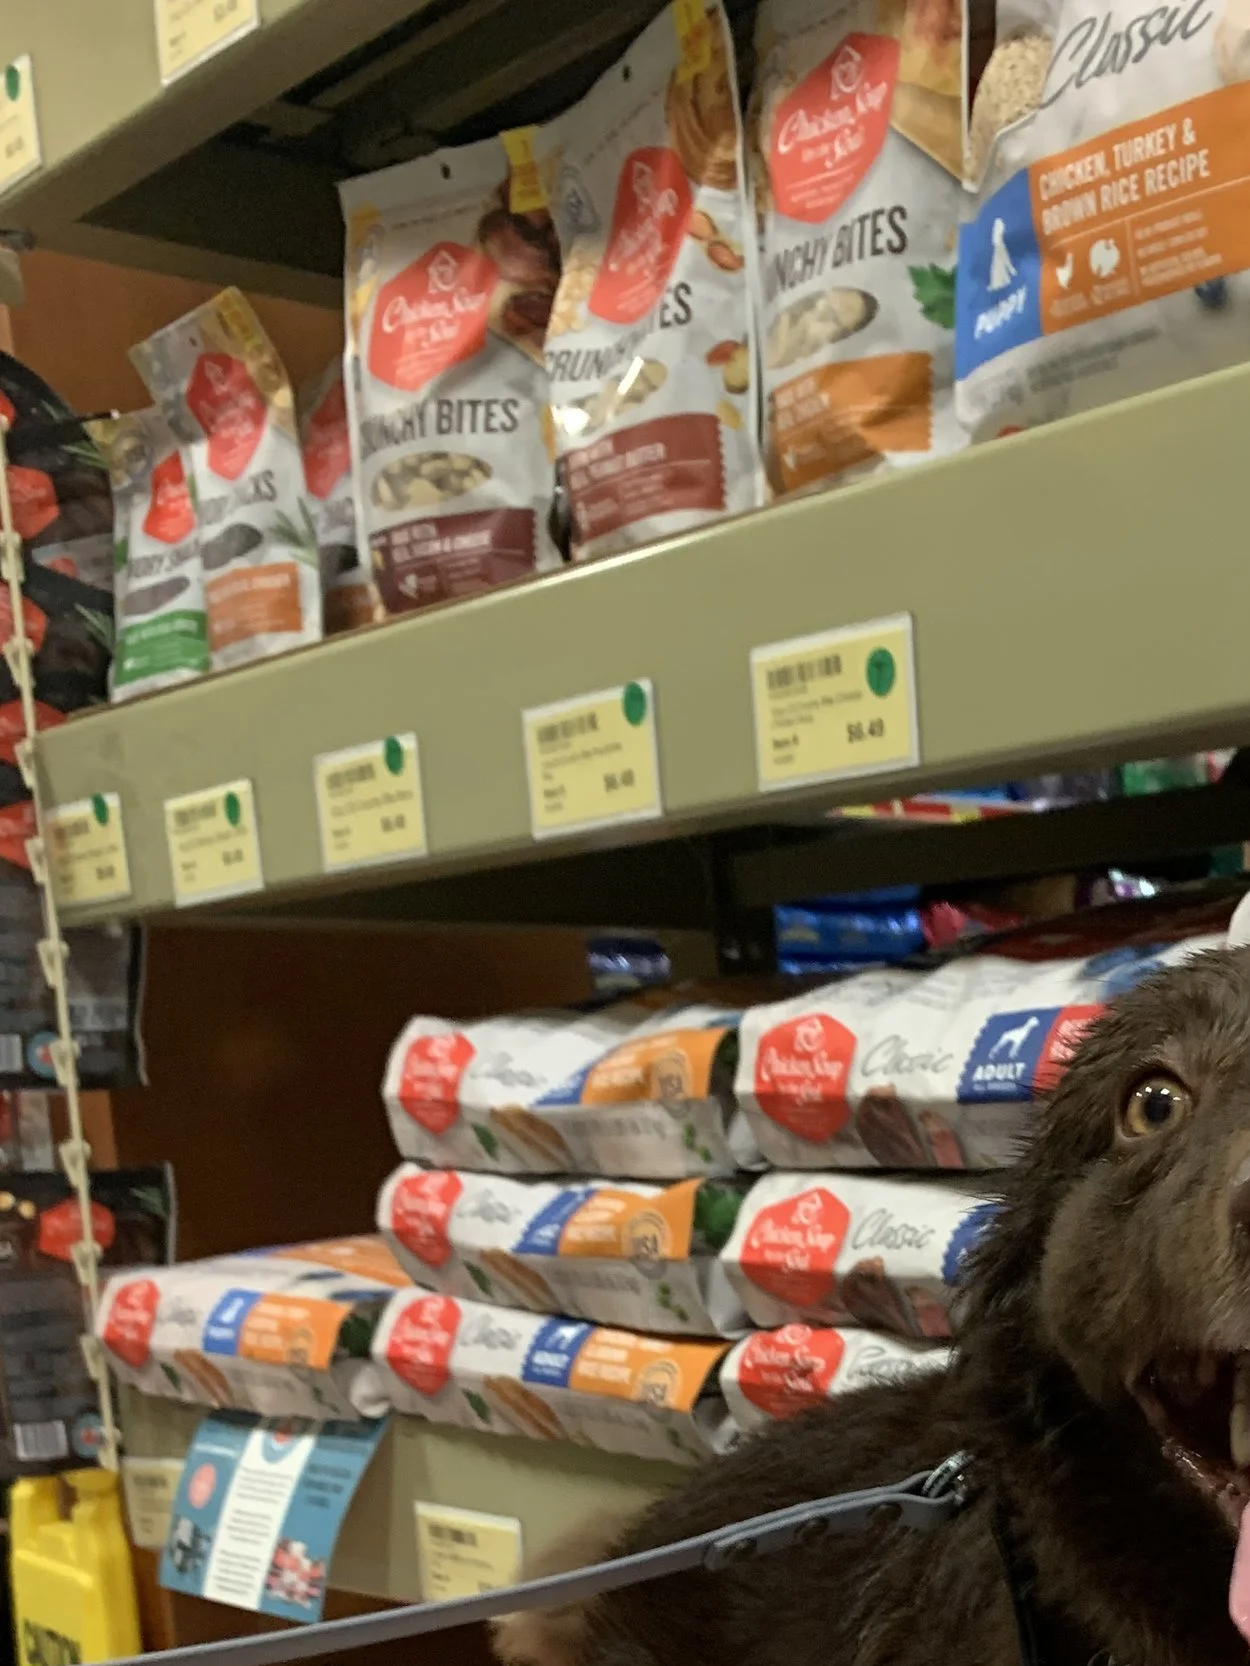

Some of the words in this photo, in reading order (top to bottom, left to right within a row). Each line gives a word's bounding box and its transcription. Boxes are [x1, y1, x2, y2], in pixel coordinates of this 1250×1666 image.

[1113, 126, 1177, 172] TURKEY
[1182, 117, 1197, 145] &
[1042, 190, 1098, 235] BROWN
[1100, 178, 1139, 212] RICE
[1144, 149, 1211, 190] RECIPE
[832, 205, 908, 269] BITES
[436, 399, 519, 435] BITES
[860, 1034, 955, 1079] Classic
[973, 1062, 1026, 1083] ADULT
[850, 1208, 937, 1251] Classic
